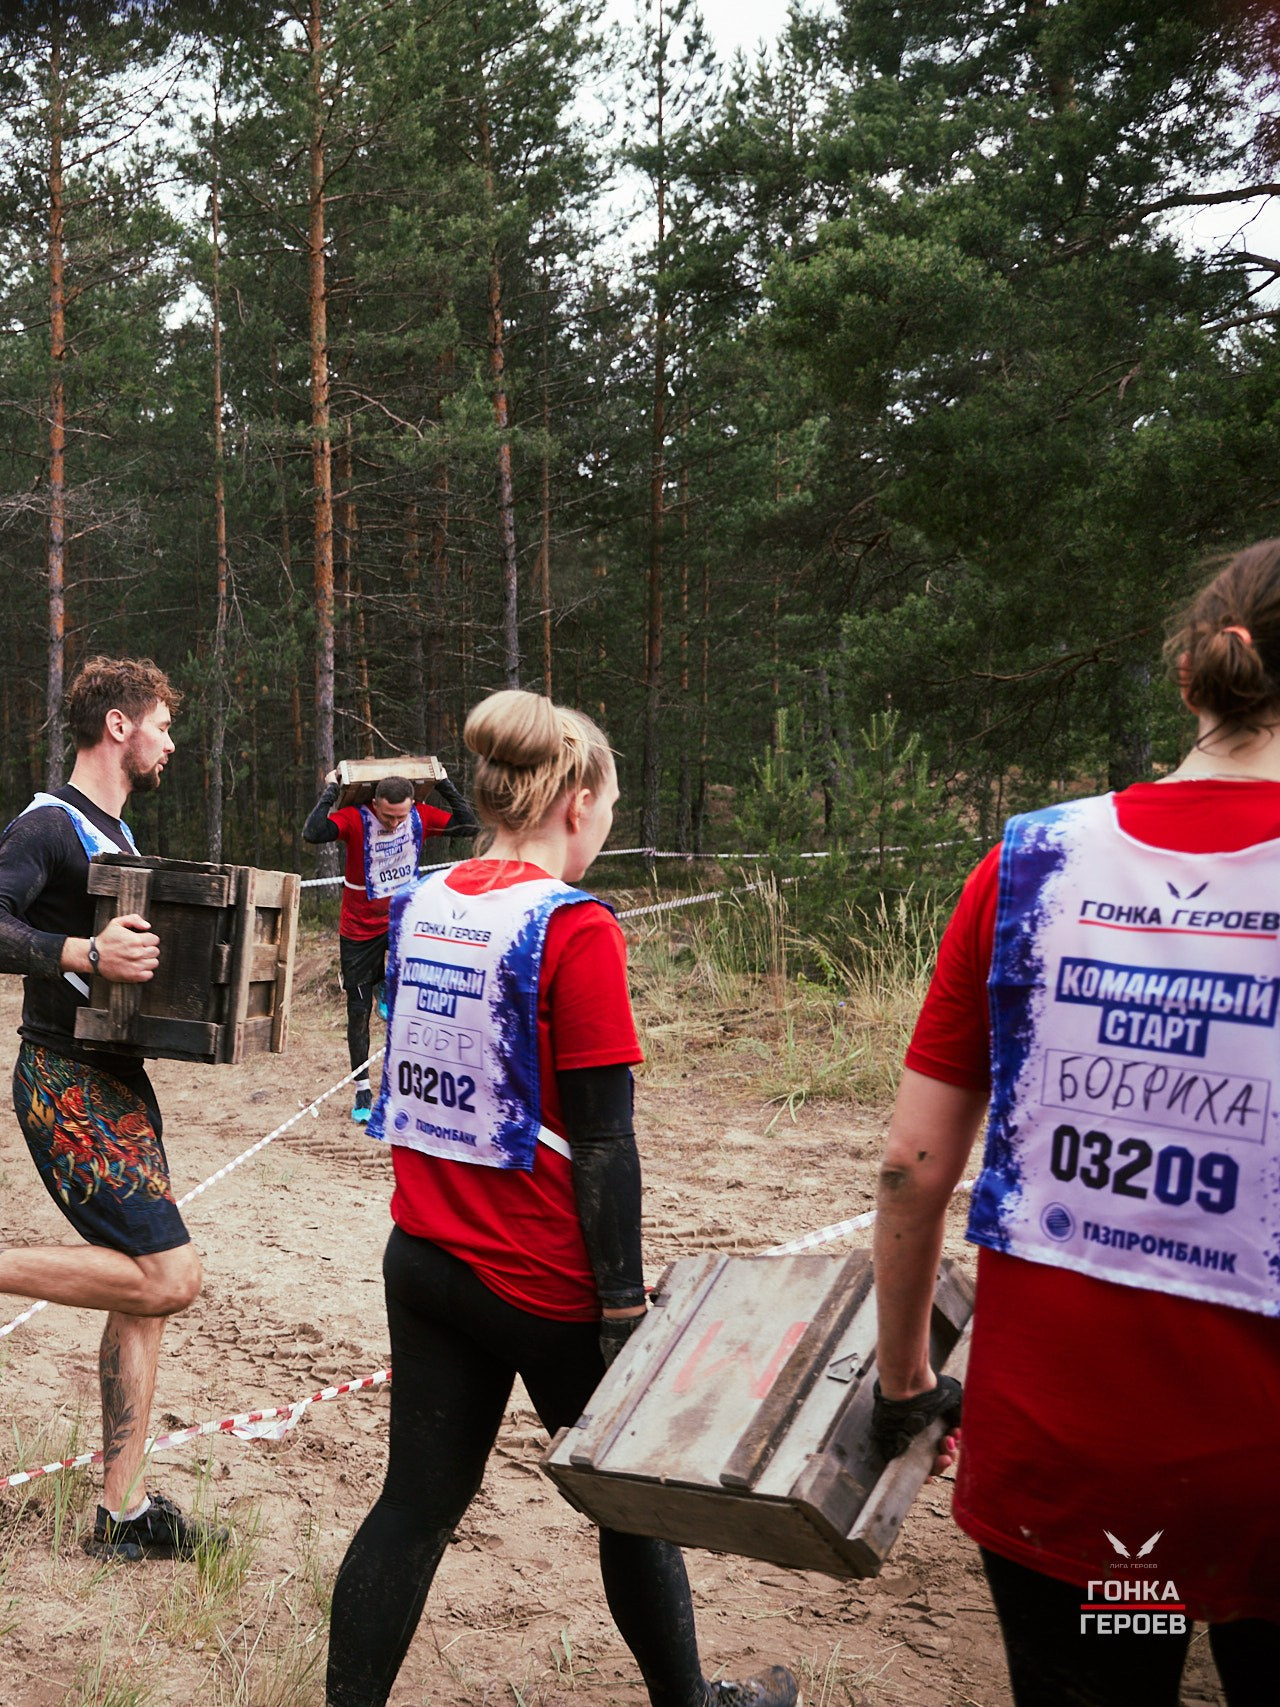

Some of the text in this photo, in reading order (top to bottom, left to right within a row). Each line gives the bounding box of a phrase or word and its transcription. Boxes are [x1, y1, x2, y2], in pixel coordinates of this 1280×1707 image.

[380, 865, 411, 883] 03203
[414, 921, 491, 942] ГОНКА ГЕРОЕВ
[1080, 900, 1280, 931] ГОНКА ГЕРОЕВ
[401, 961, 484, 996] КОМАНДНЫЙ
[1061, 963, 1275, 1020] КОМАНДНЫЙ
[418, 991, 456, 1016] СТАРТ
[406, 1021, 475, 1061] БОБР
[1105, 1009, 1203, 1050] СТАРТ
[398, 1060, 476, 1113] 03202
[1059, 1055, 1260, 1126] БОБРИХА
[1050, 1124, 1239, 1215] 03209
[1082, 1221, 1238, 1274] ГАЗПРОМБАНК
